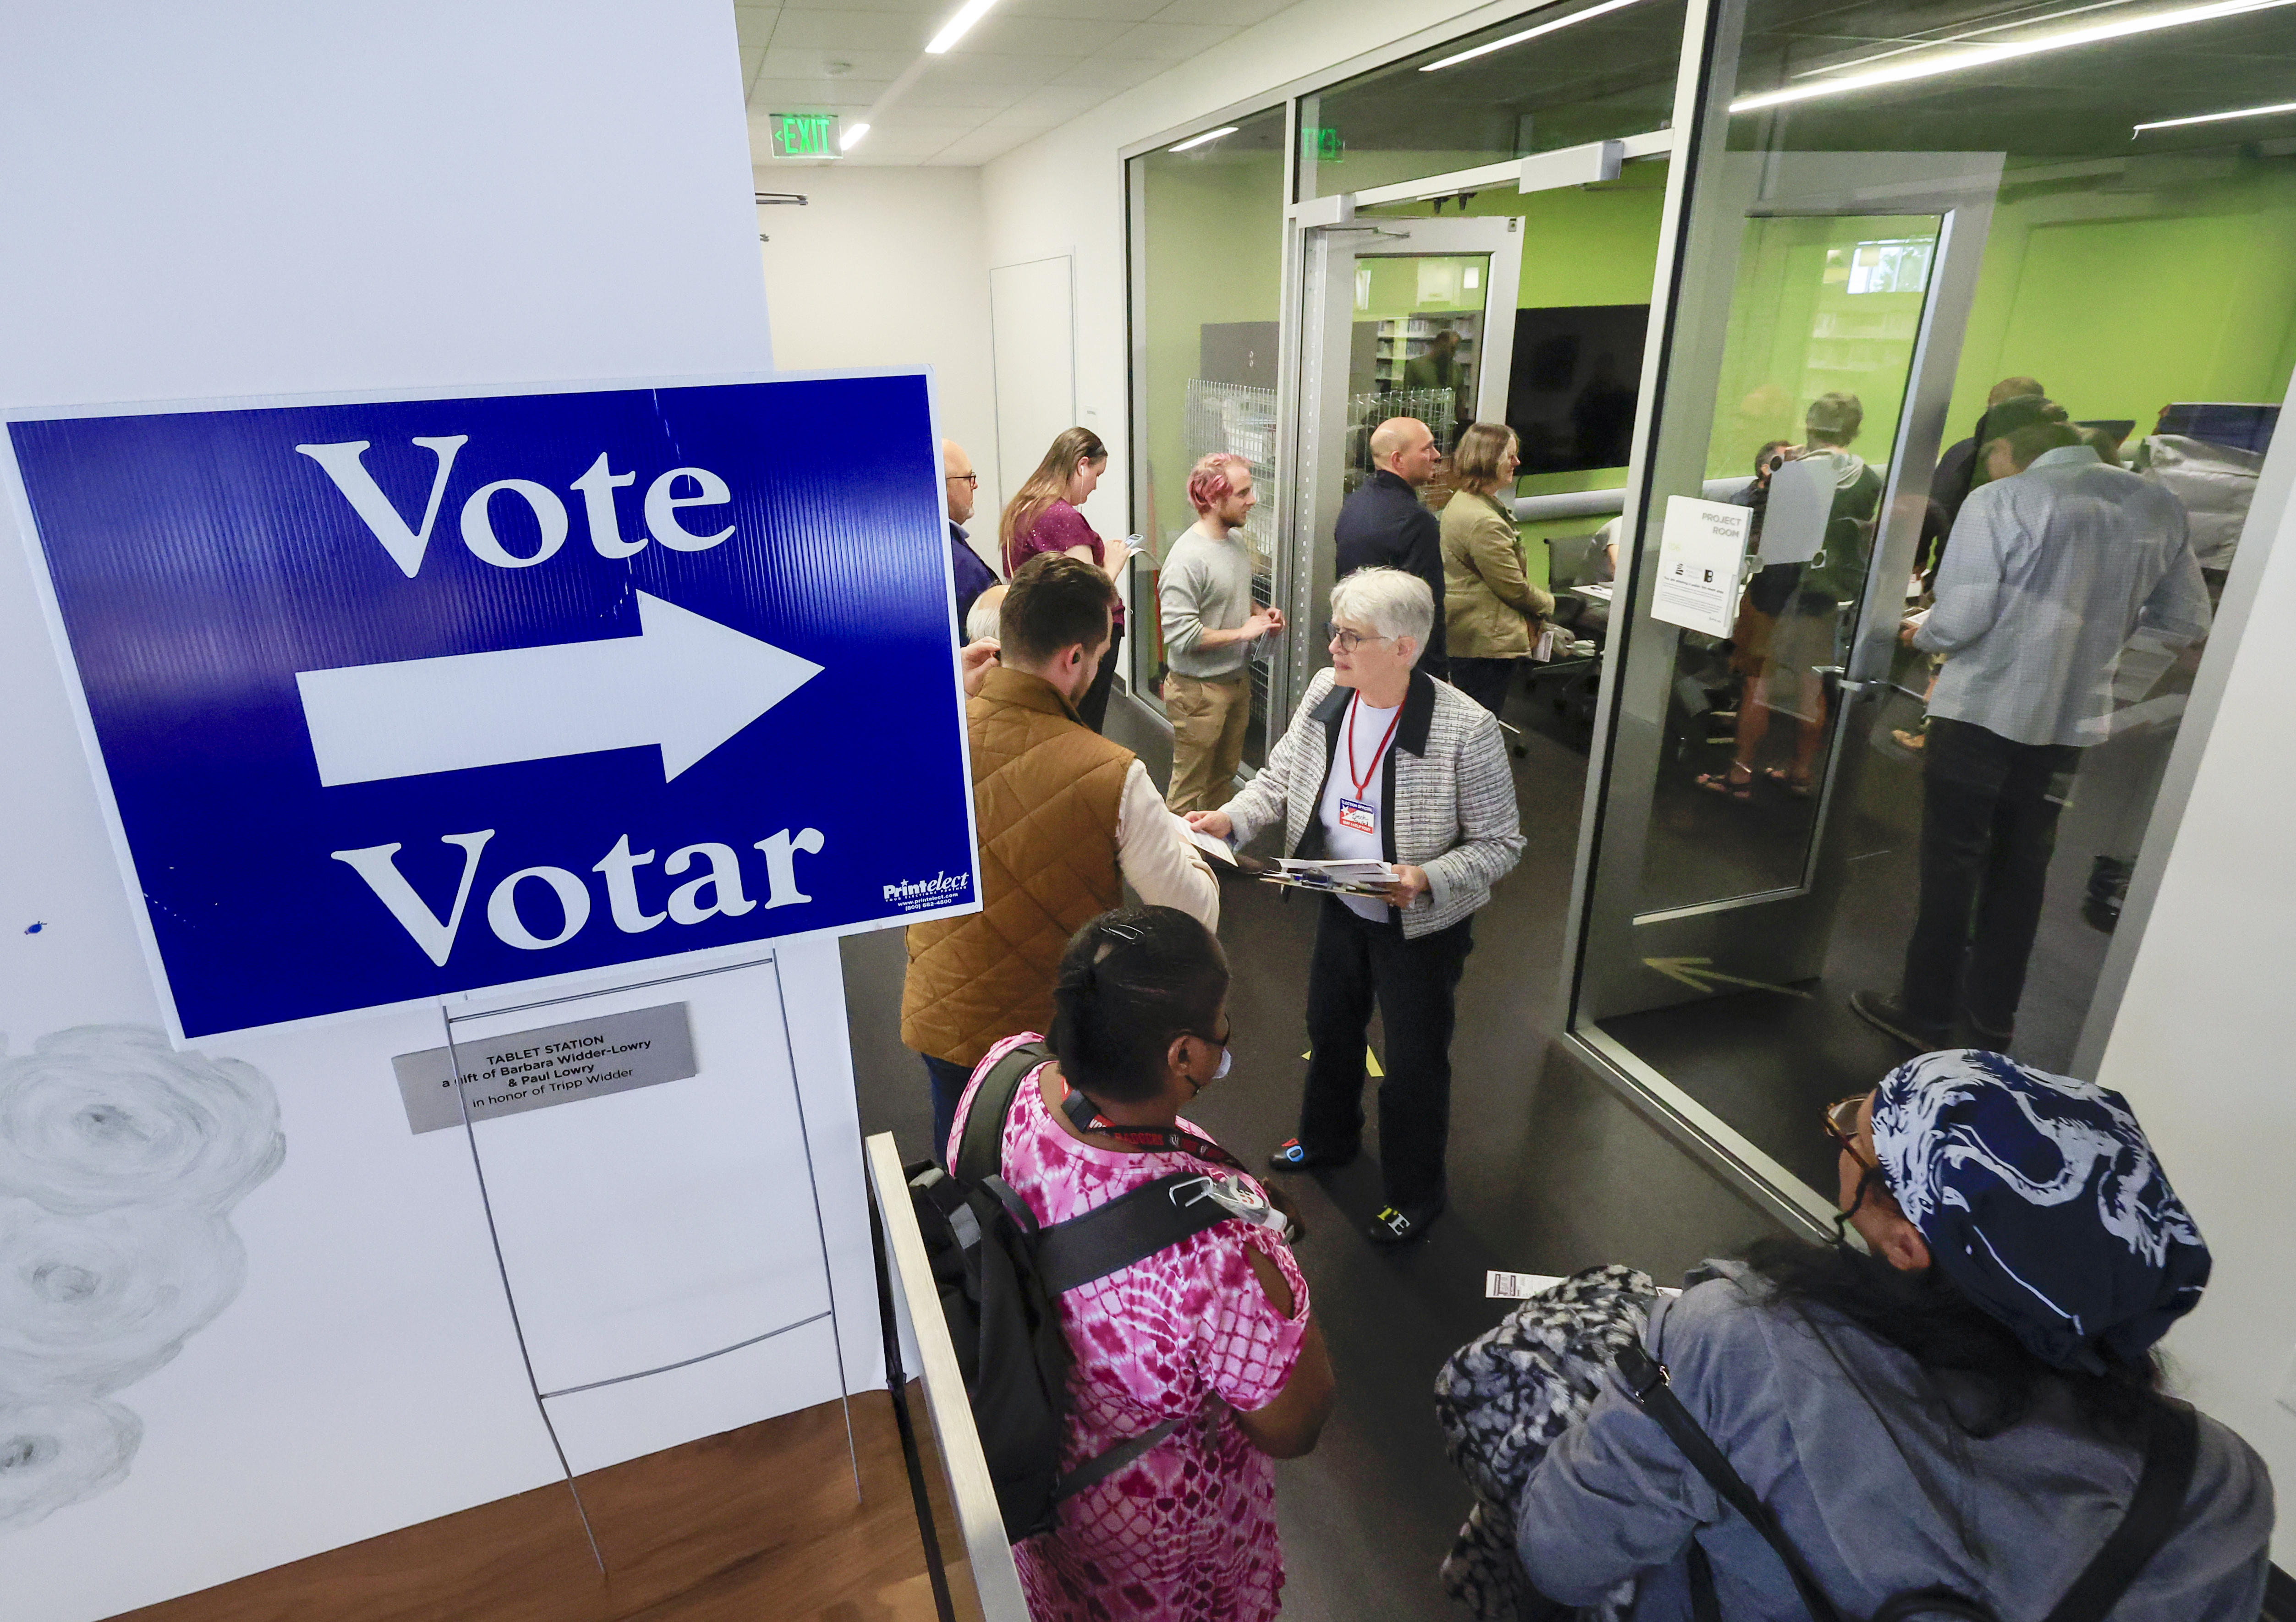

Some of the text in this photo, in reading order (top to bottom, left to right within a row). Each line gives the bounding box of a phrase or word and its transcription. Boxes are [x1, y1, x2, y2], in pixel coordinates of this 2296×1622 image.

[783, 118, 830, 153] EXIT
[296, 434, 735, 578] Vote
[1702, 513, 1742, 526] PROJECT
[1713, 526, 1740, 537] ROOM
[331, 828, 824, 967] Votar
[883, 871, 970, 899] Printelect
[898, 893, 959, 907] www.printelect.com
[905, 904, 921, 912] (800)
[482, 1069, 496, 1080] of
[500, 1060, 553, 1076] Barbara
[557, 1040, 651, 1064] Widder-Lowry
[486, 1035, 604, 1065] TABLET STATION
[473, 1069, 633, 1107] in honor of Tripp Widder
[508, 1064, 594, 1087] & Paul Lowry
